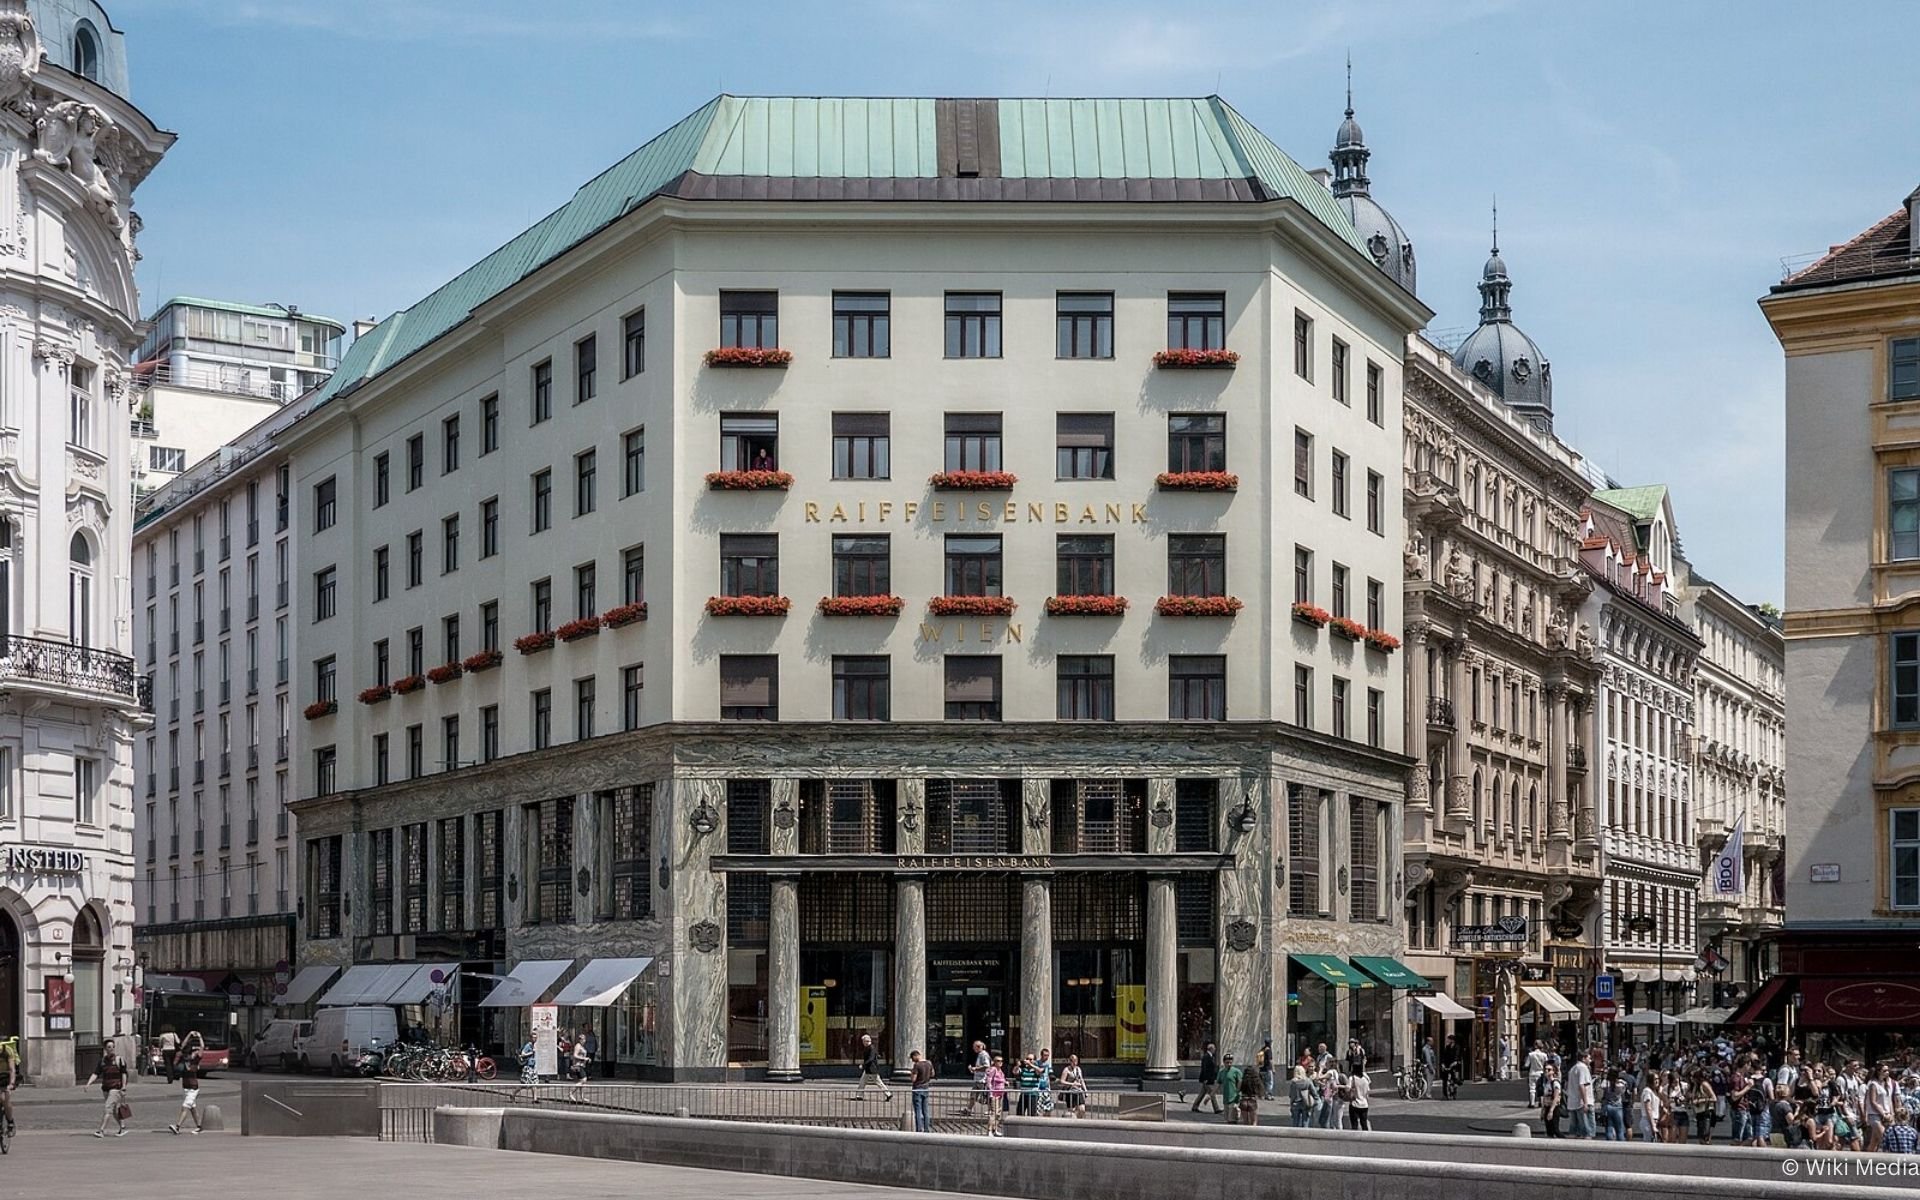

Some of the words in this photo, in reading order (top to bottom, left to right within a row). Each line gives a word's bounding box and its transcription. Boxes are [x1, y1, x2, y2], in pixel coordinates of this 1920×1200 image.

[805, 502, 1149, 523] RAIFFEISENBANK
[919, 623, 1023, 644] WIEN
[898, 857, 1052, 868] RAIFFEISENBANK
[1720, 857, 1733, 888] BDO
[932, 959, 982, 967] RAIFFEISENBANK
[983, 959, 1000, 967] WIEN
